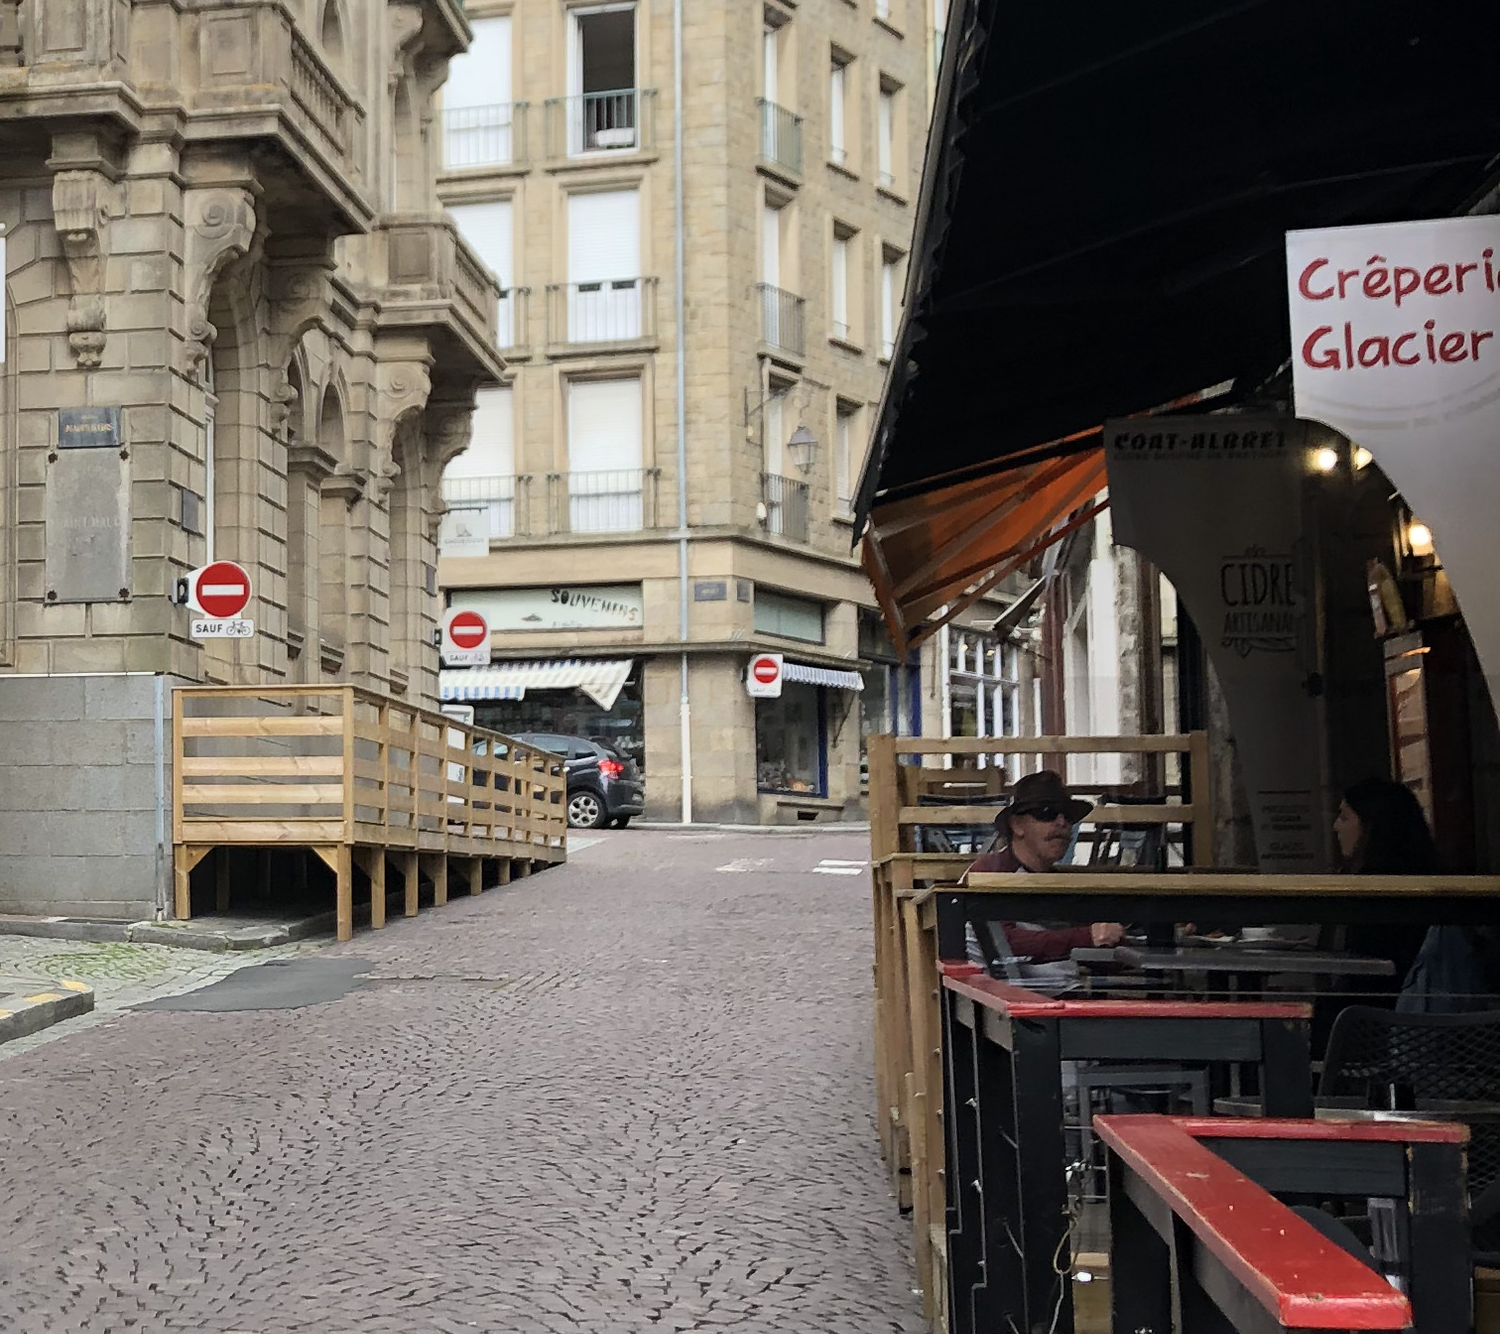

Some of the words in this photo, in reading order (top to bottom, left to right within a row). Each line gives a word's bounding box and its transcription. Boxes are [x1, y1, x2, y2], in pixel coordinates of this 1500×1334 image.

[1299, 247, 1500, 308] Crêperi
[1302, 319, 1494, 370] Glacier
[1221, 562, 1296, 606] CIDRE
[195, 623, 223, 634] SAUF
